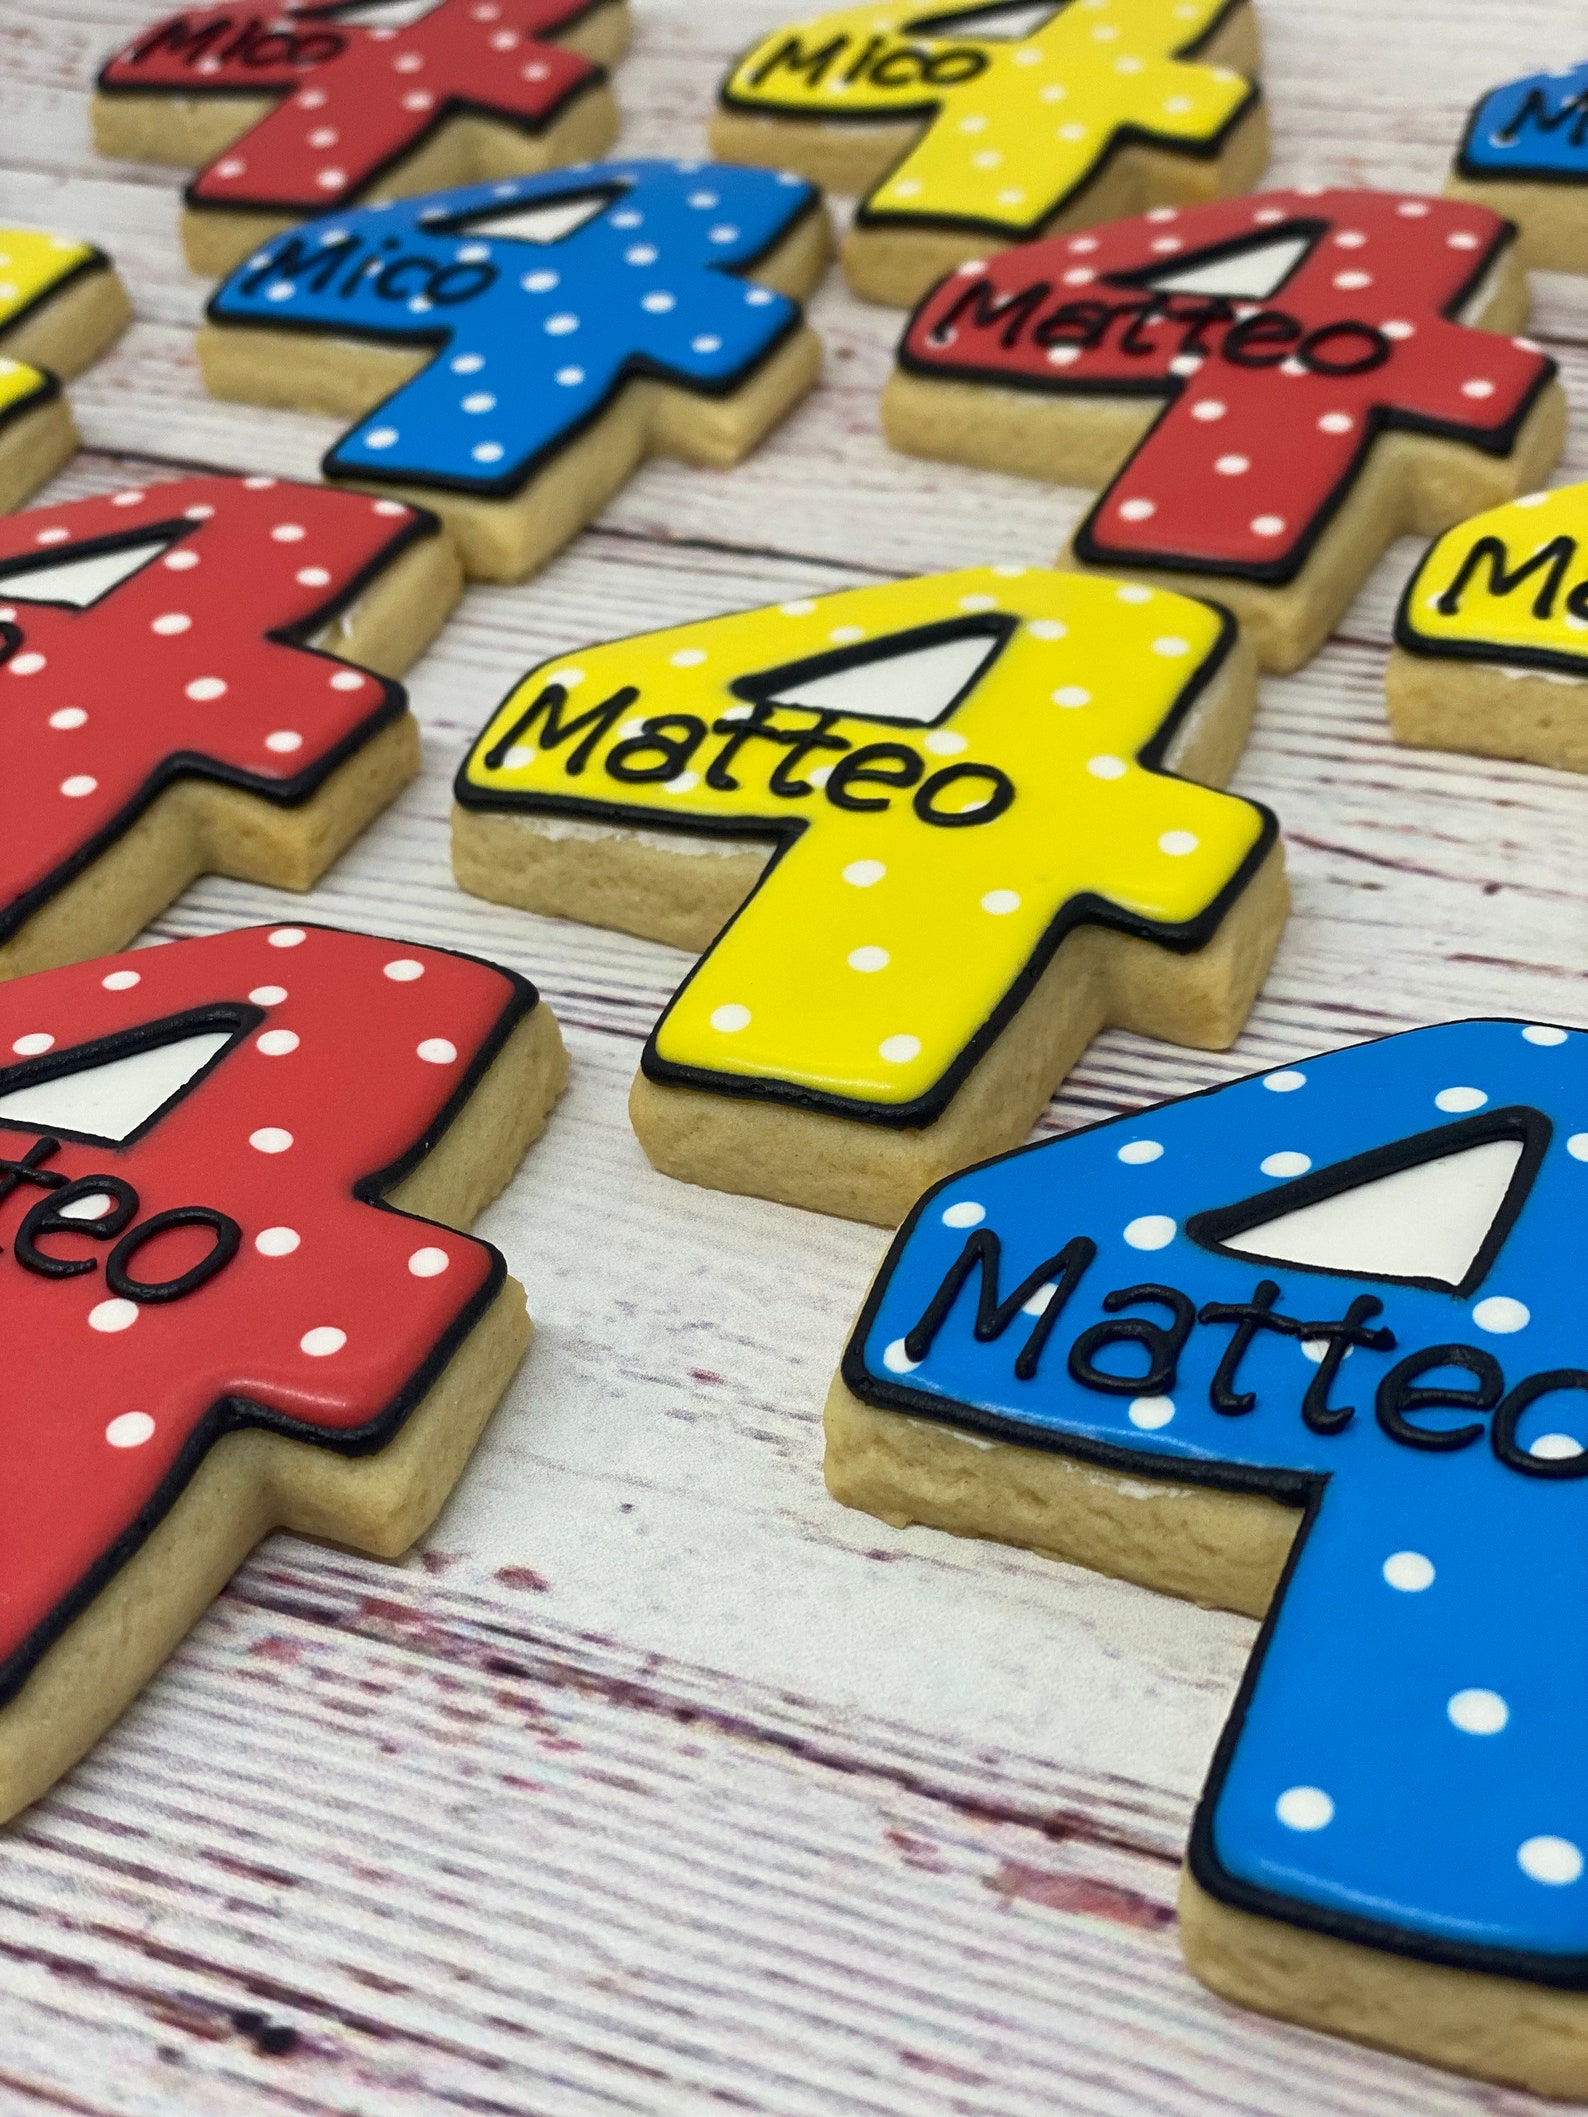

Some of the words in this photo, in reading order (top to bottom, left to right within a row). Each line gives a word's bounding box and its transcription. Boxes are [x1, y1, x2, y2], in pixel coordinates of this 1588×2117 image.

[750, 32, 990, 88] Mico
[240, 236, 498, 306] Mico
[932, 280, 1393, 378] Matteo
[483, 682, 1017, 828] Matteo
[903, 1229, 1588, 1480] Matteo
